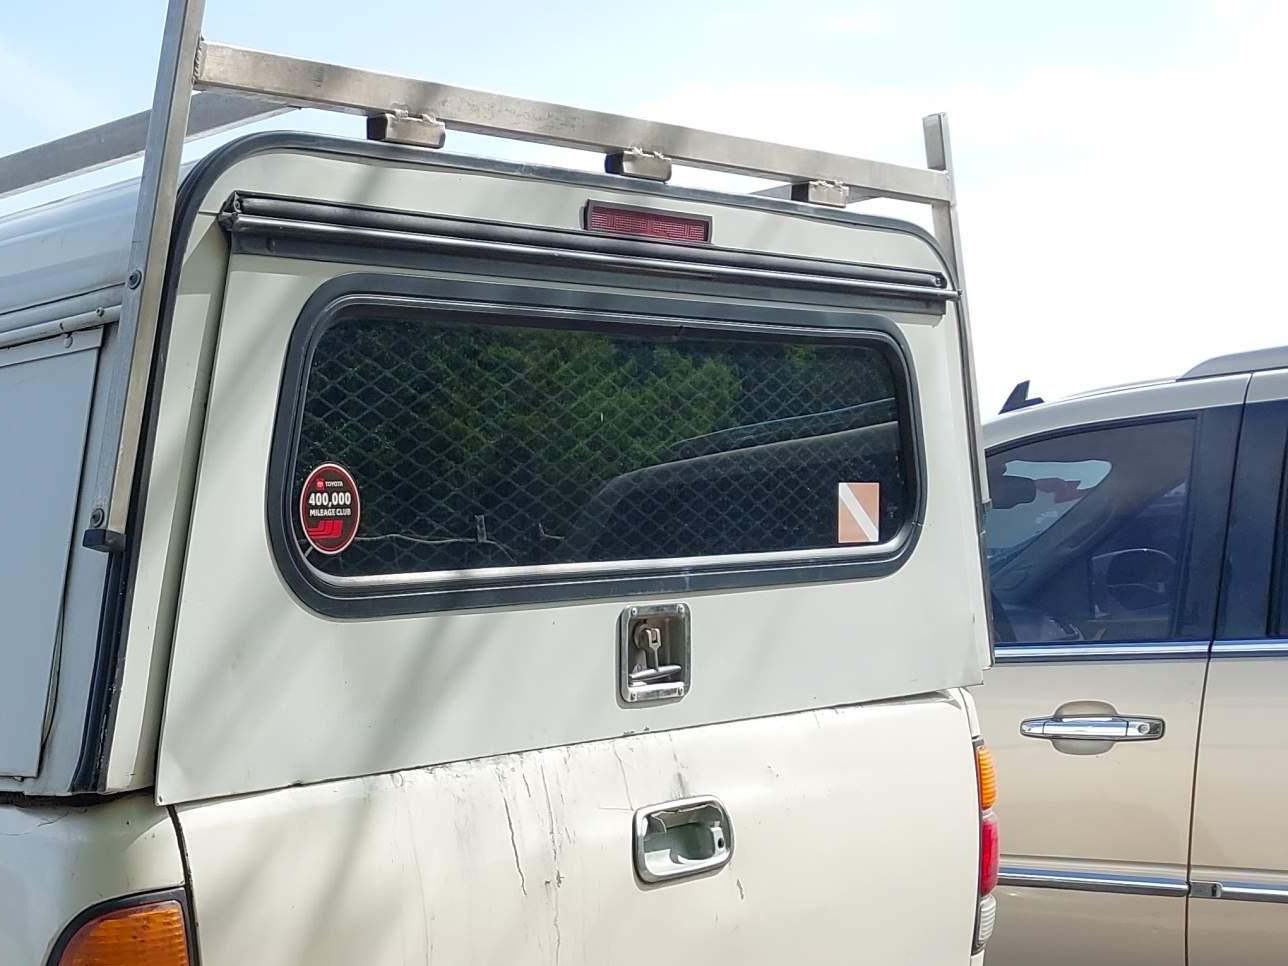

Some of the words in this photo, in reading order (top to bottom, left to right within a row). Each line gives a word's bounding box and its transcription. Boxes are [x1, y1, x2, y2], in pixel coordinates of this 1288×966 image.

[325, 480, 344, 488] TOYOTA
[308, 492, 351, 507] 400,000
[309, 508, 336, 517] MILEAGE
[336, 507, 351, 516] CLUB
